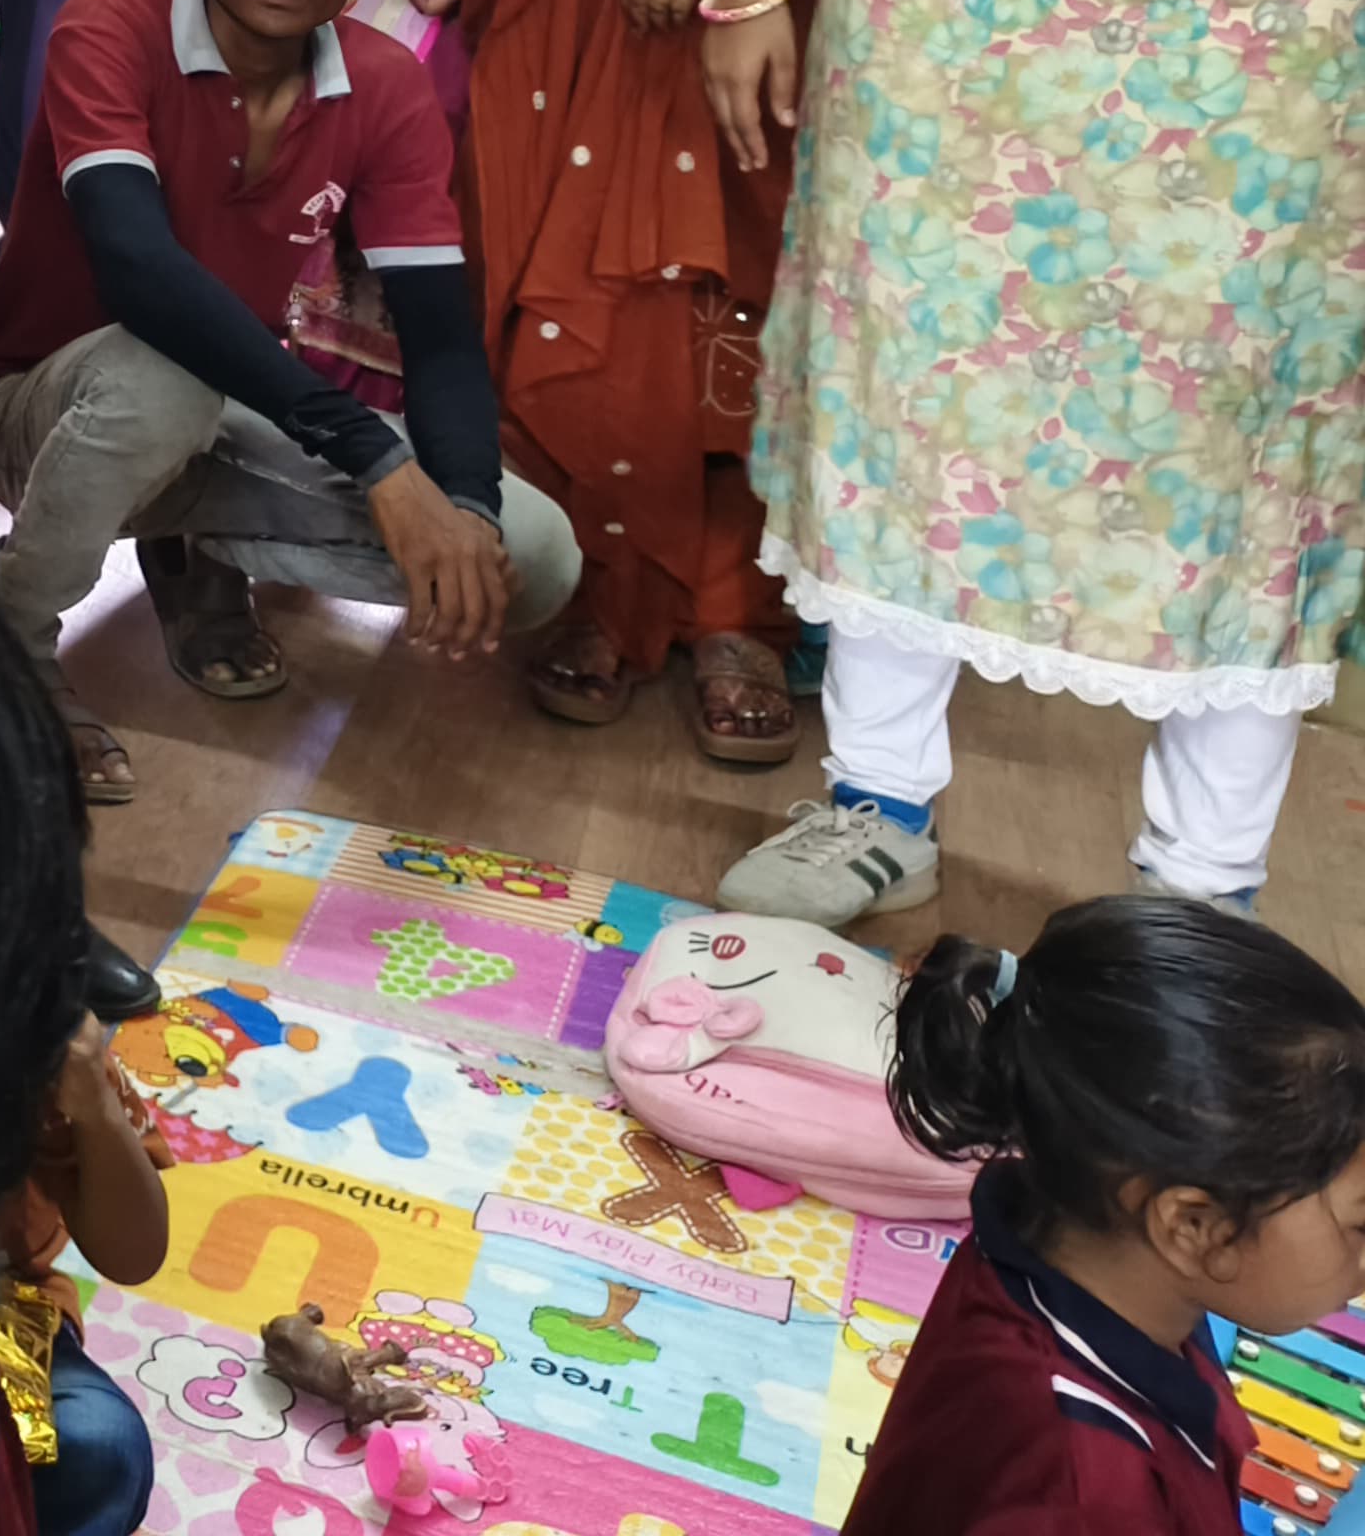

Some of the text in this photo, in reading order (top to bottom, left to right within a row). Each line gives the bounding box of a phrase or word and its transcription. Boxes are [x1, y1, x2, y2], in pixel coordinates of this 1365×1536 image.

[286, 1055, 429, 1159] Y
[260, 1158, 441, 1229] Umbrella
[509, 1206, 759, 1306] Baby Play Mat
[530, 1356, 643, 1413] Tree
[650, 1392, 780, 1487] T
